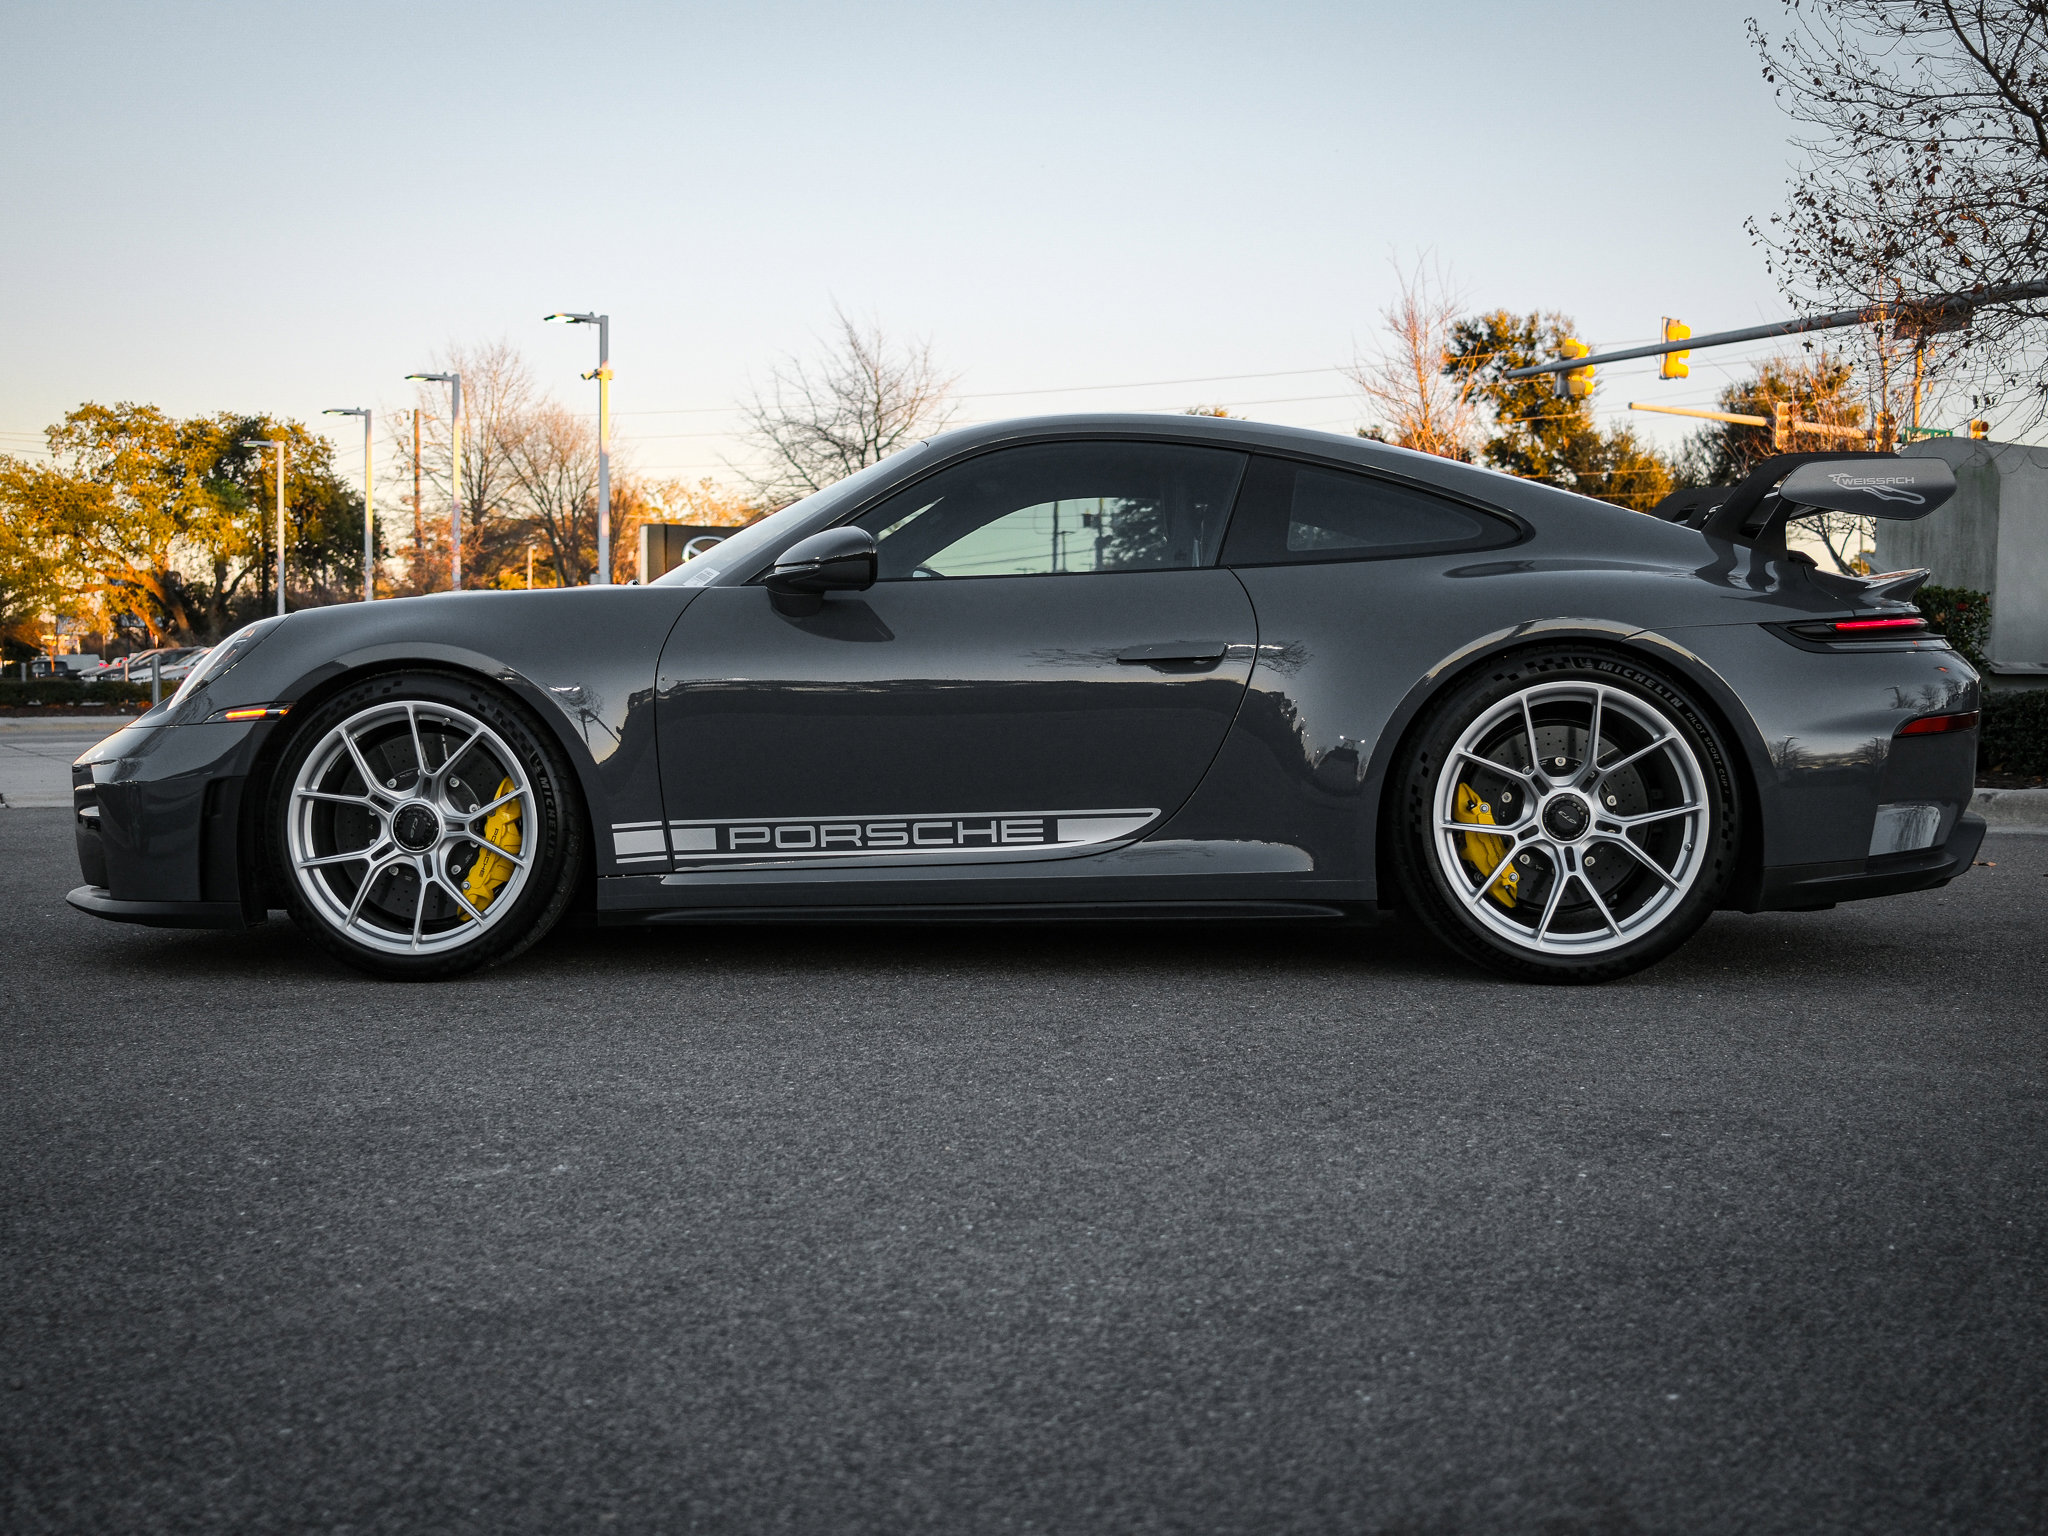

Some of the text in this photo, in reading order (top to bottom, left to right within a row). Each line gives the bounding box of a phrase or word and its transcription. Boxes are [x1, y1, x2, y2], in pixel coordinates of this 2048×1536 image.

[1842, 476, 1915, 485] WEISSACH
[1598, 661, 1683, 708] MICHELIN
[1685, 712, 1705, 734] PILOT
[1704, 736, 1722, 766] SPORT
[1718, 768, 1728, 789] CUP
[539, 776, 556, 858] MICHELIN
[729, 819, 1044, 850] PORSCHE
[479, 828, 499, 878] POSCHE
